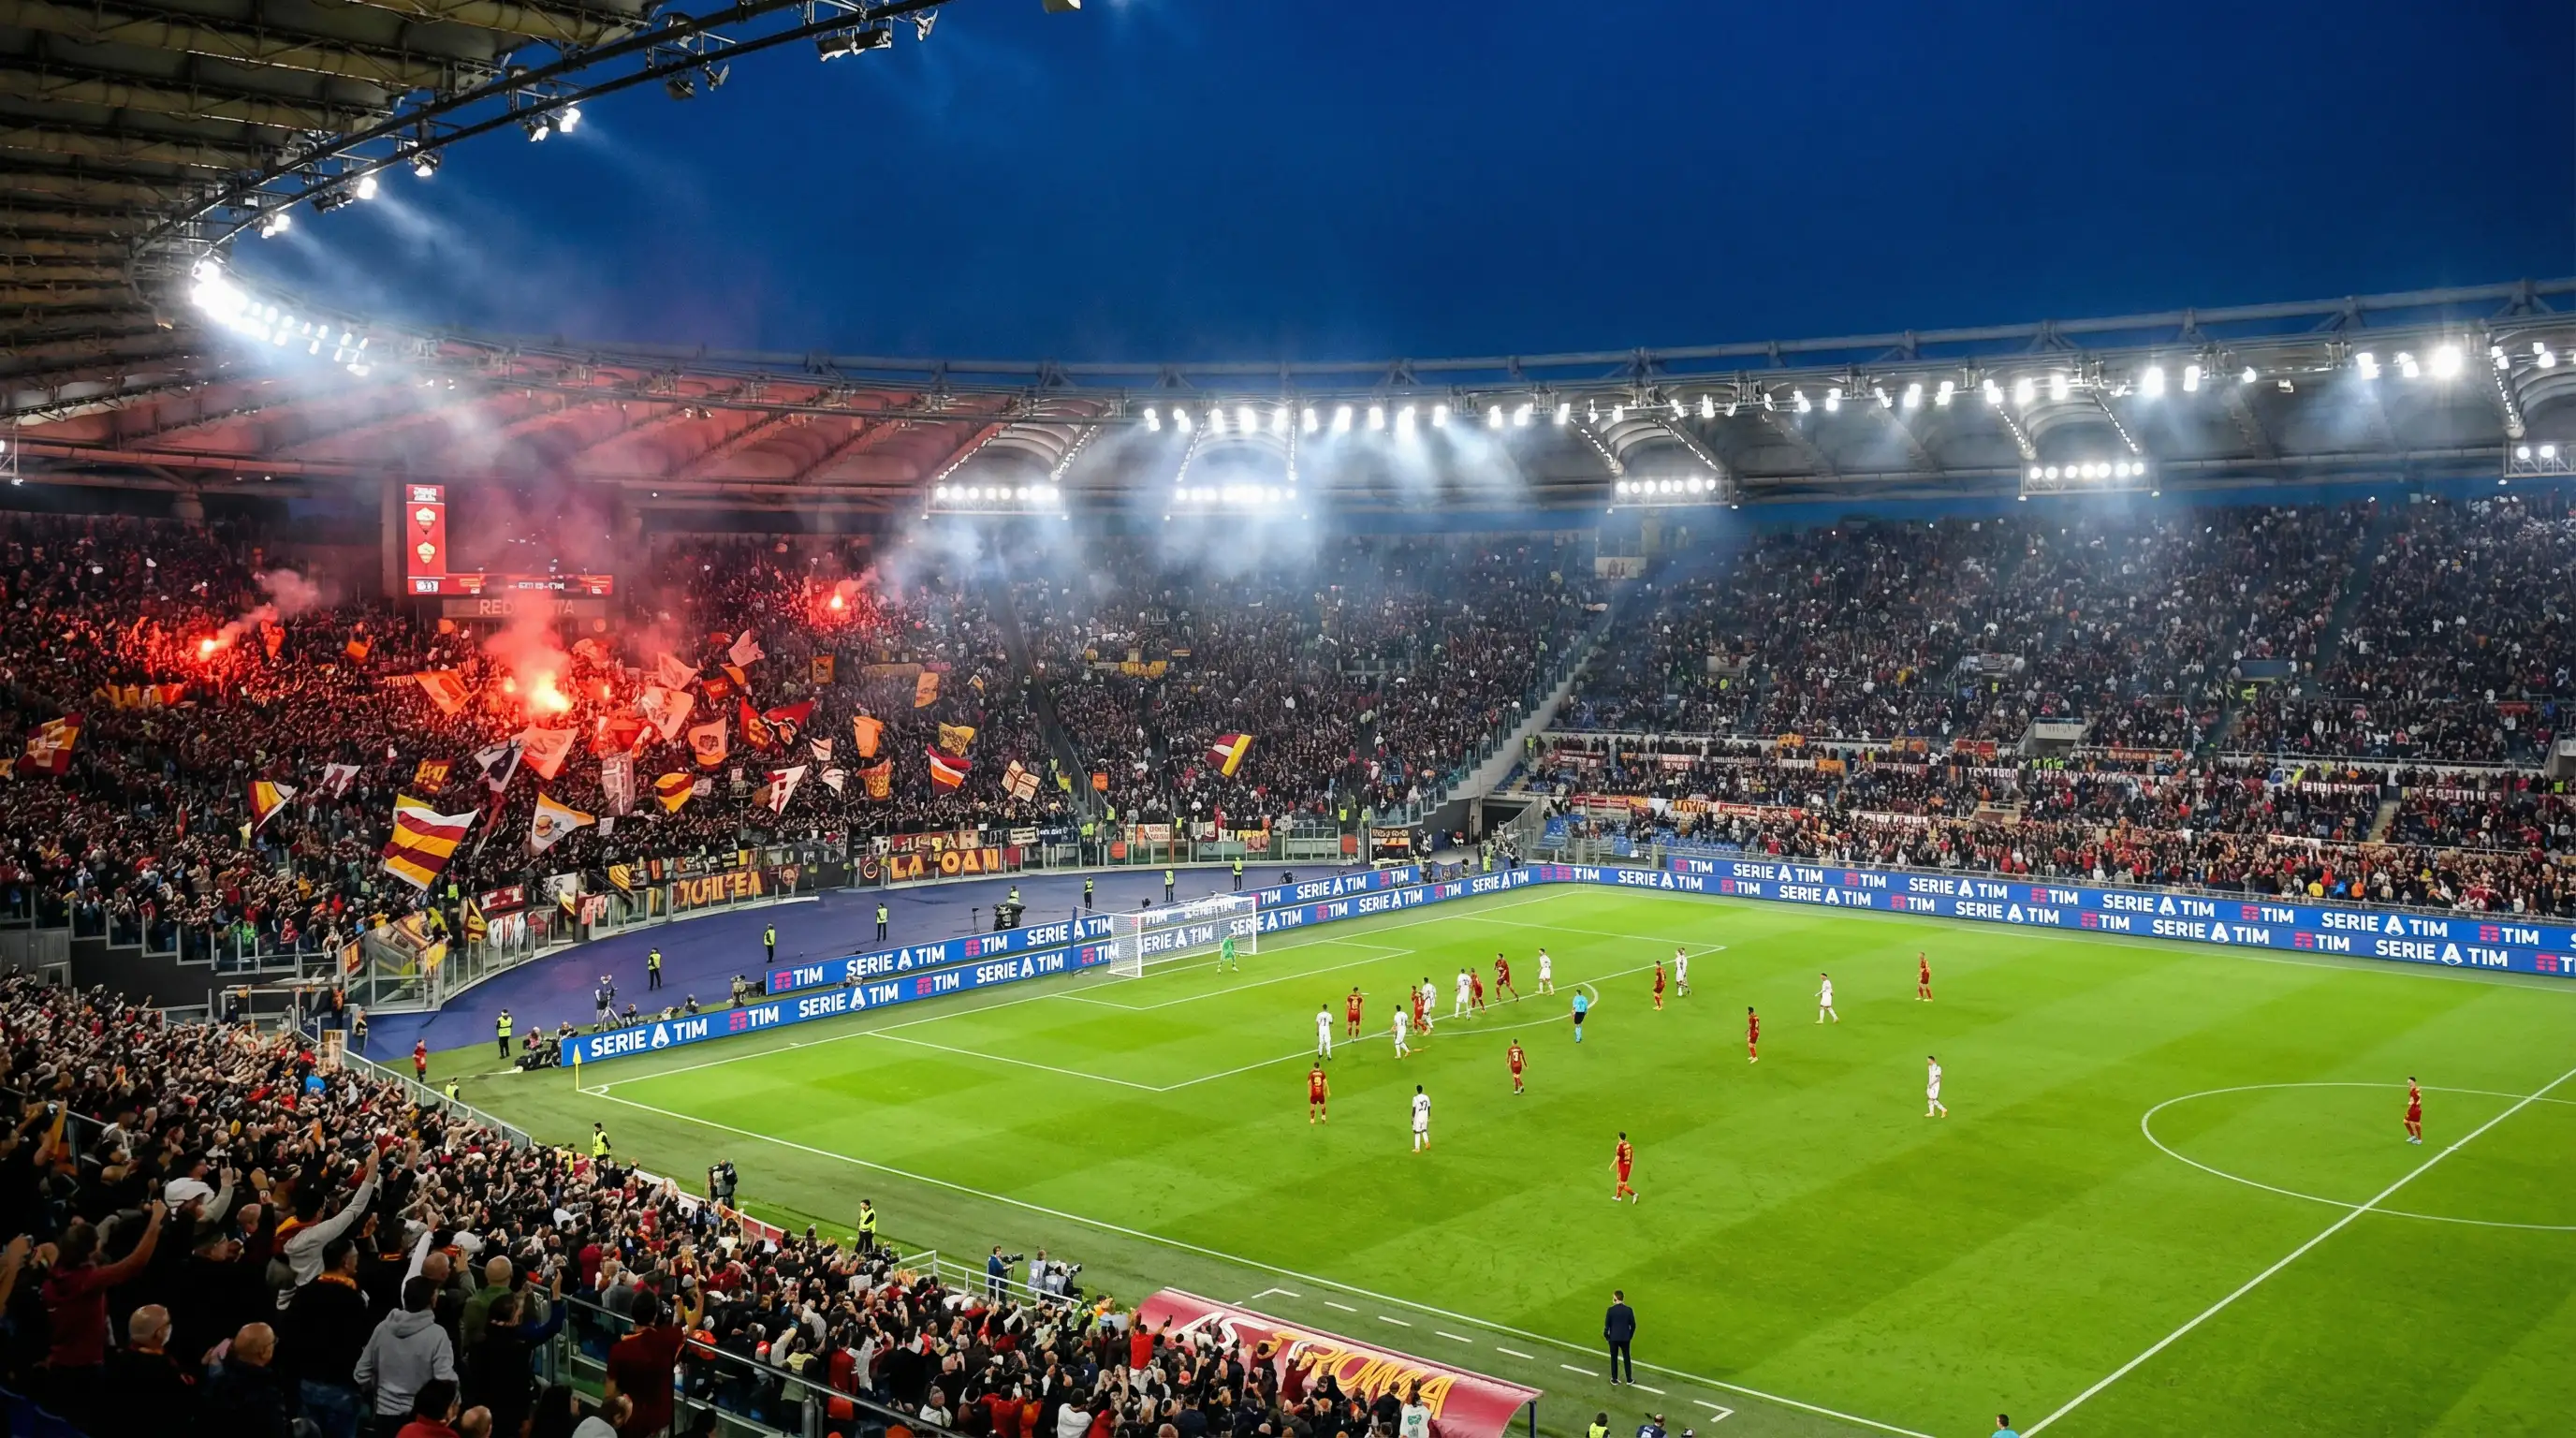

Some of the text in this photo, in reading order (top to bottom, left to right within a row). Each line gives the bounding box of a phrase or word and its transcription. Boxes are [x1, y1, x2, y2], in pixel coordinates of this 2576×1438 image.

[1391, 869, 1409, 883] TIM
[1574, 868, 1600, 880] TIM
[1689, 860, 1712, 874] TIM
[1734, 863, 1822, 883] SERIE A TIM
[1297, 875, 1366, 899] SERIE A TIM
[1445, 883, 1461, 896] TIM
[1472, 871, 1529, 893] SERIE A TIM
[1618, 871, 1702, 890] SERIE A TIM
[1736, 881, 1760, 894] TIM
[1860, 873, 1886, 888] TIM
[1910, 878, 2007, 899] SERIE A TIM
[1261, 889, 1281, 904] TIM
[1359, 889, 1423, 913] SERIE A TIM
[1779, 886, 1871, 905] SERIE A TIM
[1908, 897, 1935, 911] TIM
[2049, 889, 2078, 904] TIM
[1328, 902, 1348, 917] TIM
[1956, 902, 2058, 924] SERIE A TIM
[2103, 894, 2214, 917] SERIE A TIM
[1230, 909, 1302, 935] SERE A TIM
[2100, 915, 2130, 930] TIM
[2261, 908, 2293, 923] TIM
[2322, 913, 2447, 937] SERIE A TIM
[1027, 917, 1113, 946] SERIE A TIM
[2153, 919, 2269, 944] SERIE A TIM
[2502, 928, 2539, 945] TIM
[982, 935, 1007, 953] TIM
[1096, 943, 1119, 961] TIM
[2316, 934, 2349, 951] TIM
[847, 946, 944, 976] SERIE A TIM
[2376, 940, 2508, 966] SERIE A TIM
[794, 966, 822, 985] TIM
[976, 953, 1062, 983] SERIE A TIM
[933, 973, 959, 990] TIM
[799, 983, 898, 1018] SERIE A TIM
[749, 1006, 779, 1026] TIM
[592, 1019, 707, 1056] SERIE A TIM
